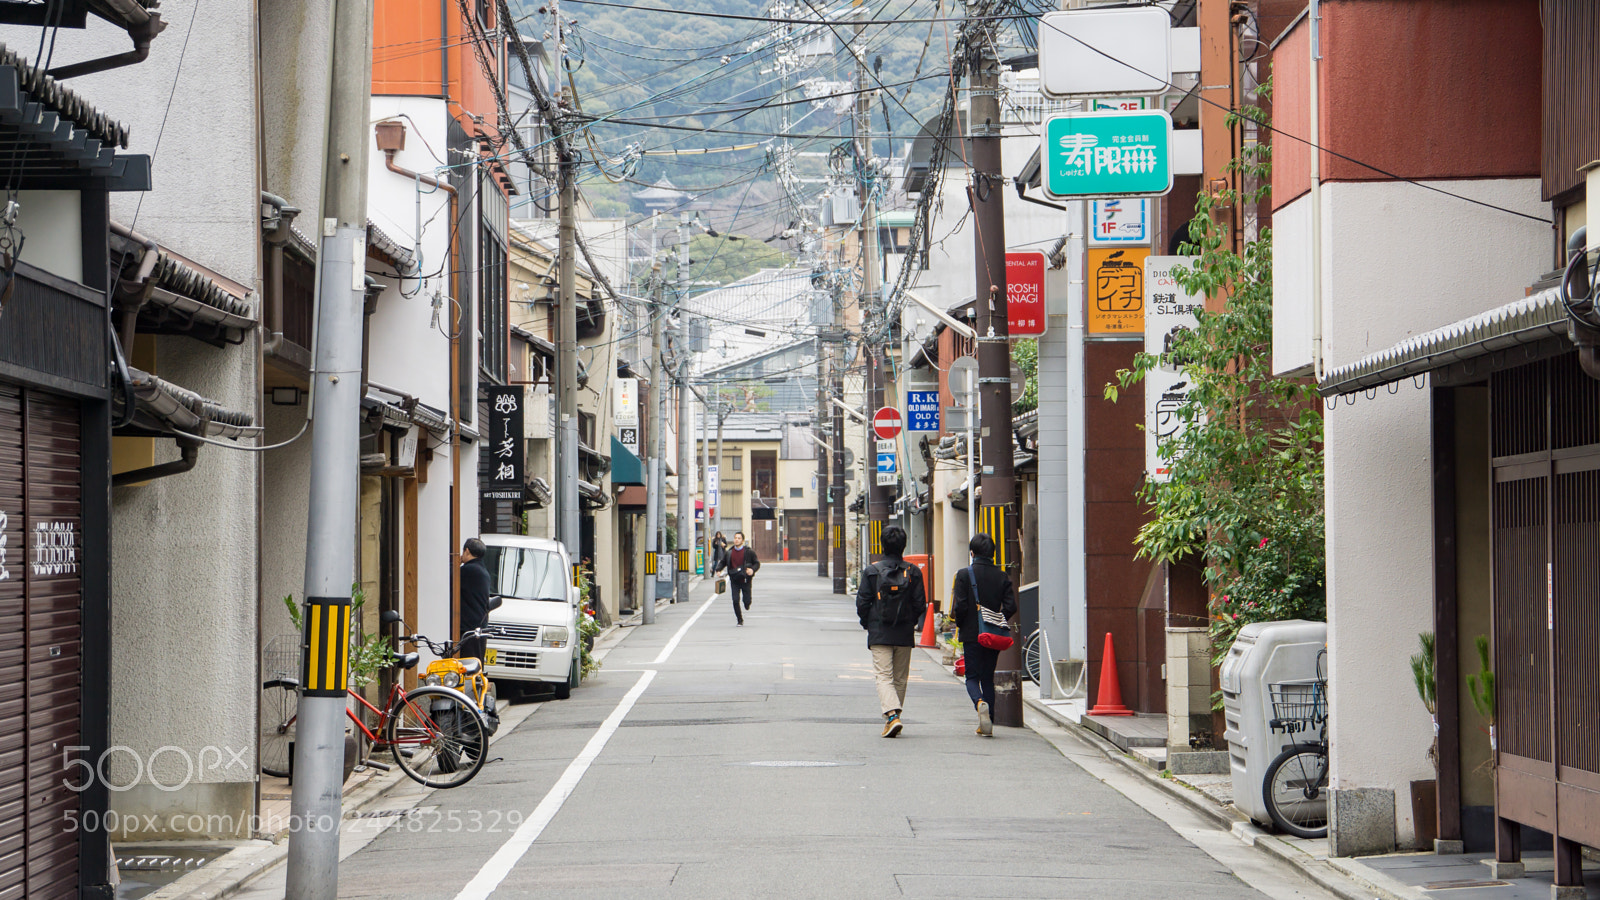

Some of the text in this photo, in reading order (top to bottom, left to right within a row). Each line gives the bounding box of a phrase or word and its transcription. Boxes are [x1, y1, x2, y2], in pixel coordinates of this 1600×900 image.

[1101, 222, 1117, 234] 1F
[1153, 292, 1176, 304] 鉄道
[915, 412, 931, 420] OLD
